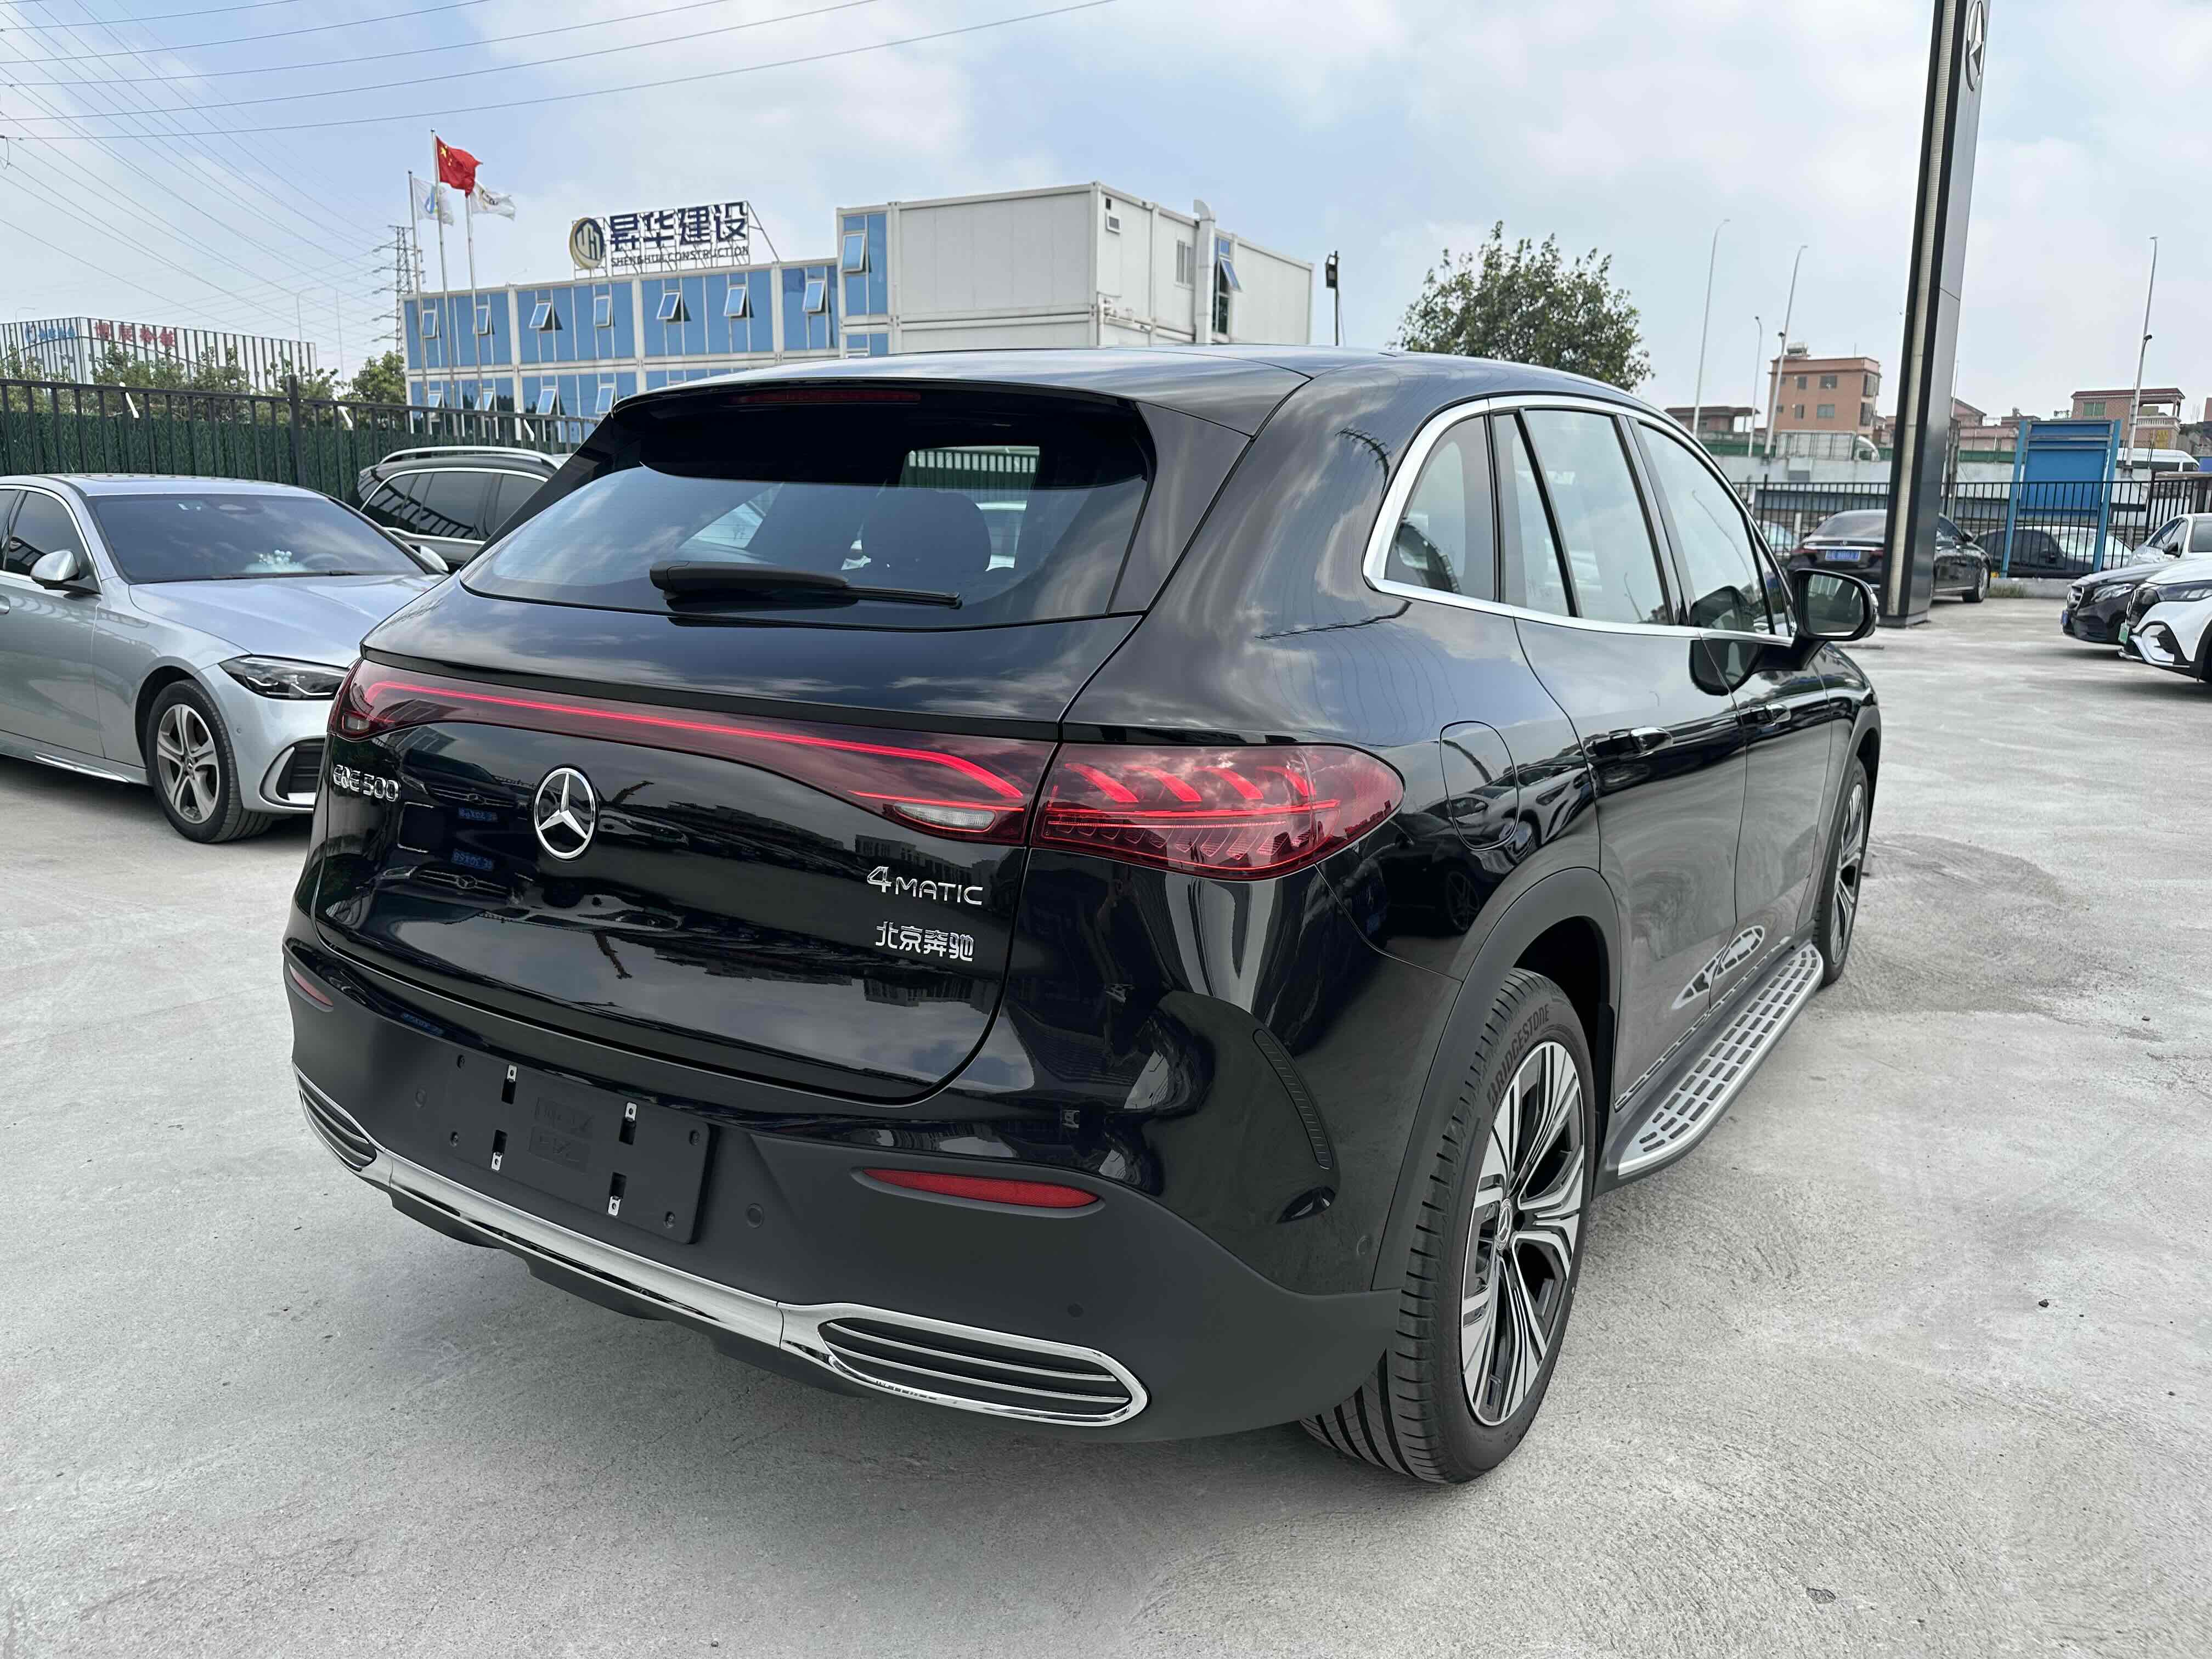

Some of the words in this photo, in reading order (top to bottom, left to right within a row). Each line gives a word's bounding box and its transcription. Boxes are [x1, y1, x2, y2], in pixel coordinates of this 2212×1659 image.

[363, 774, 399, 802] 500
[867, 866, 983, 905] 4MATIC
[875, 921, 974, 962] 北京奔驰
